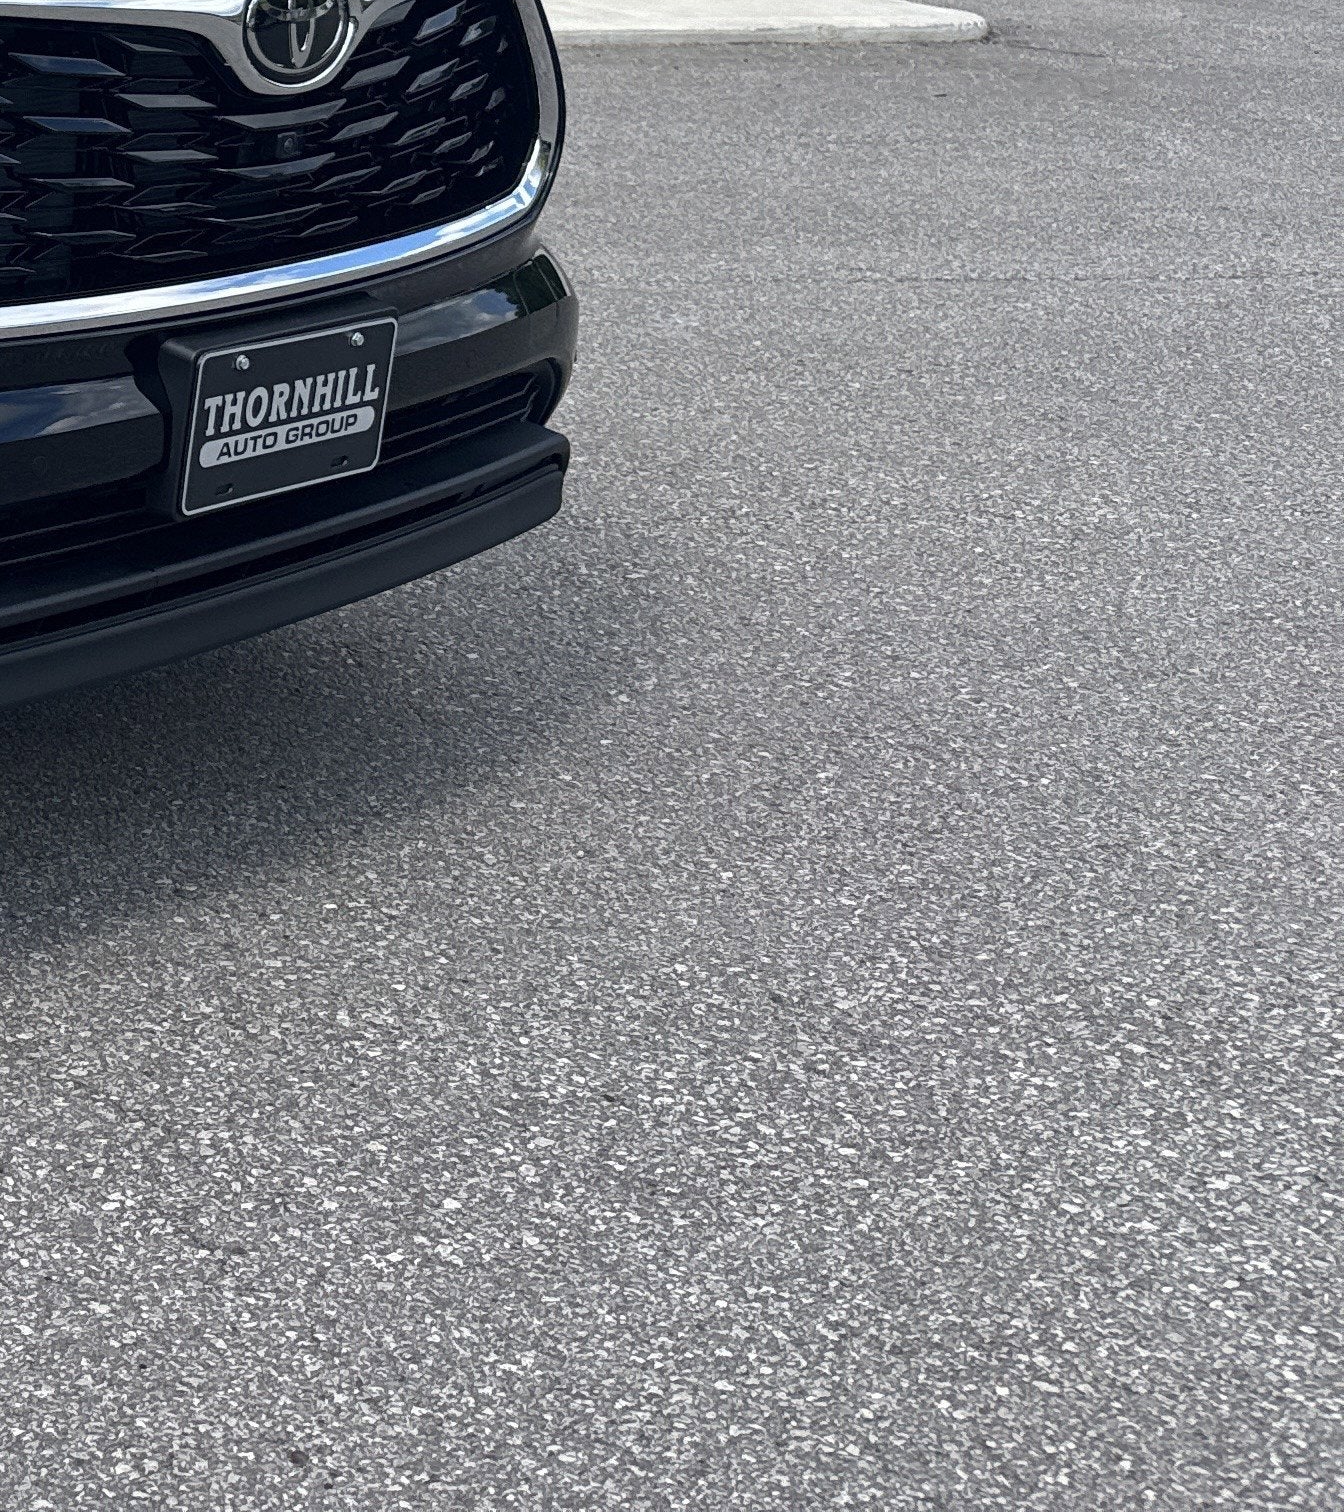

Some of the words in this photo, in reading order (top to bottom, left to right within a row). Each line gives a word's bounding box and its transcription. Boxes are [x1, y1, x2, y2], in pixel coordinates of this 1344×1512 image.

[204, 364, 379, 436] THORNHILL
[216, 433, 277, 461] AUTO
[285, 413, 358, 444] GROUP
